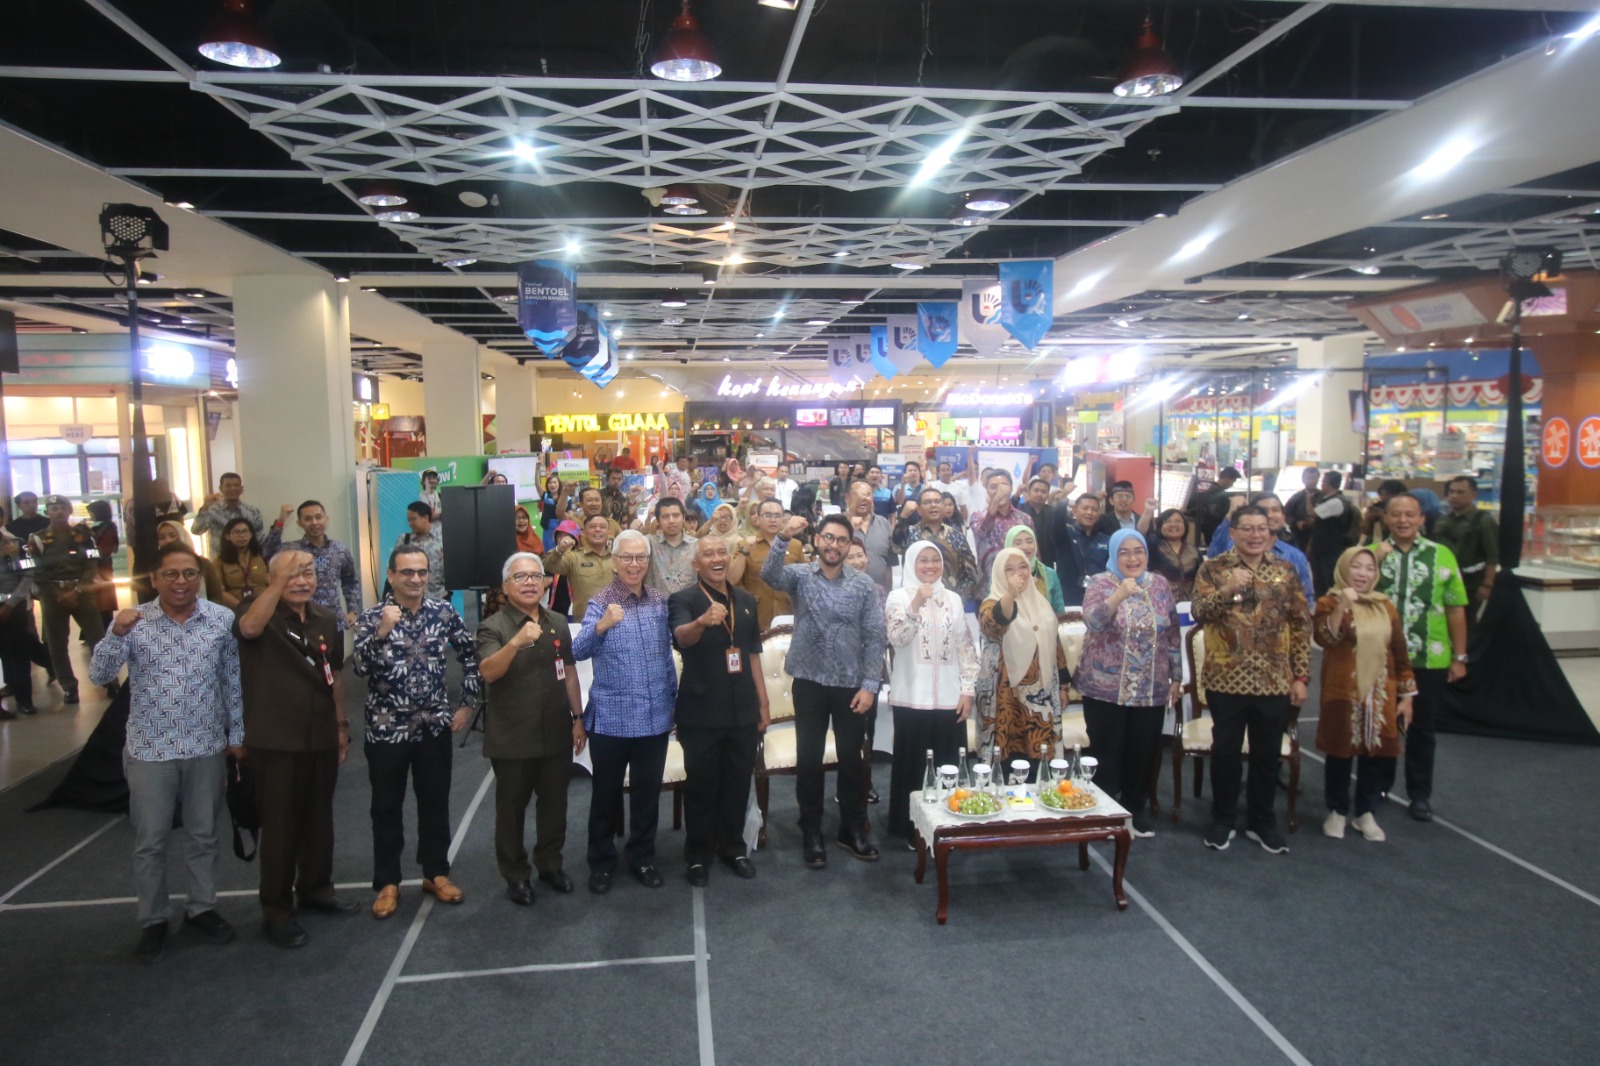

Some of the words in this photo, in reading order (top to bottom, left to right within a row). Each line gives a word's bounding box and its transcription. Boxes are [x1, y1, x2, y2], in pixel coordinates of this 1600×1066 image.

[525, 287, 569, 296] BENTOEL
[717, 374, 762, 398] kopi
[946, 392, 1033, 406] McDonald's
[544, 412, 601, 434] PENTOL
